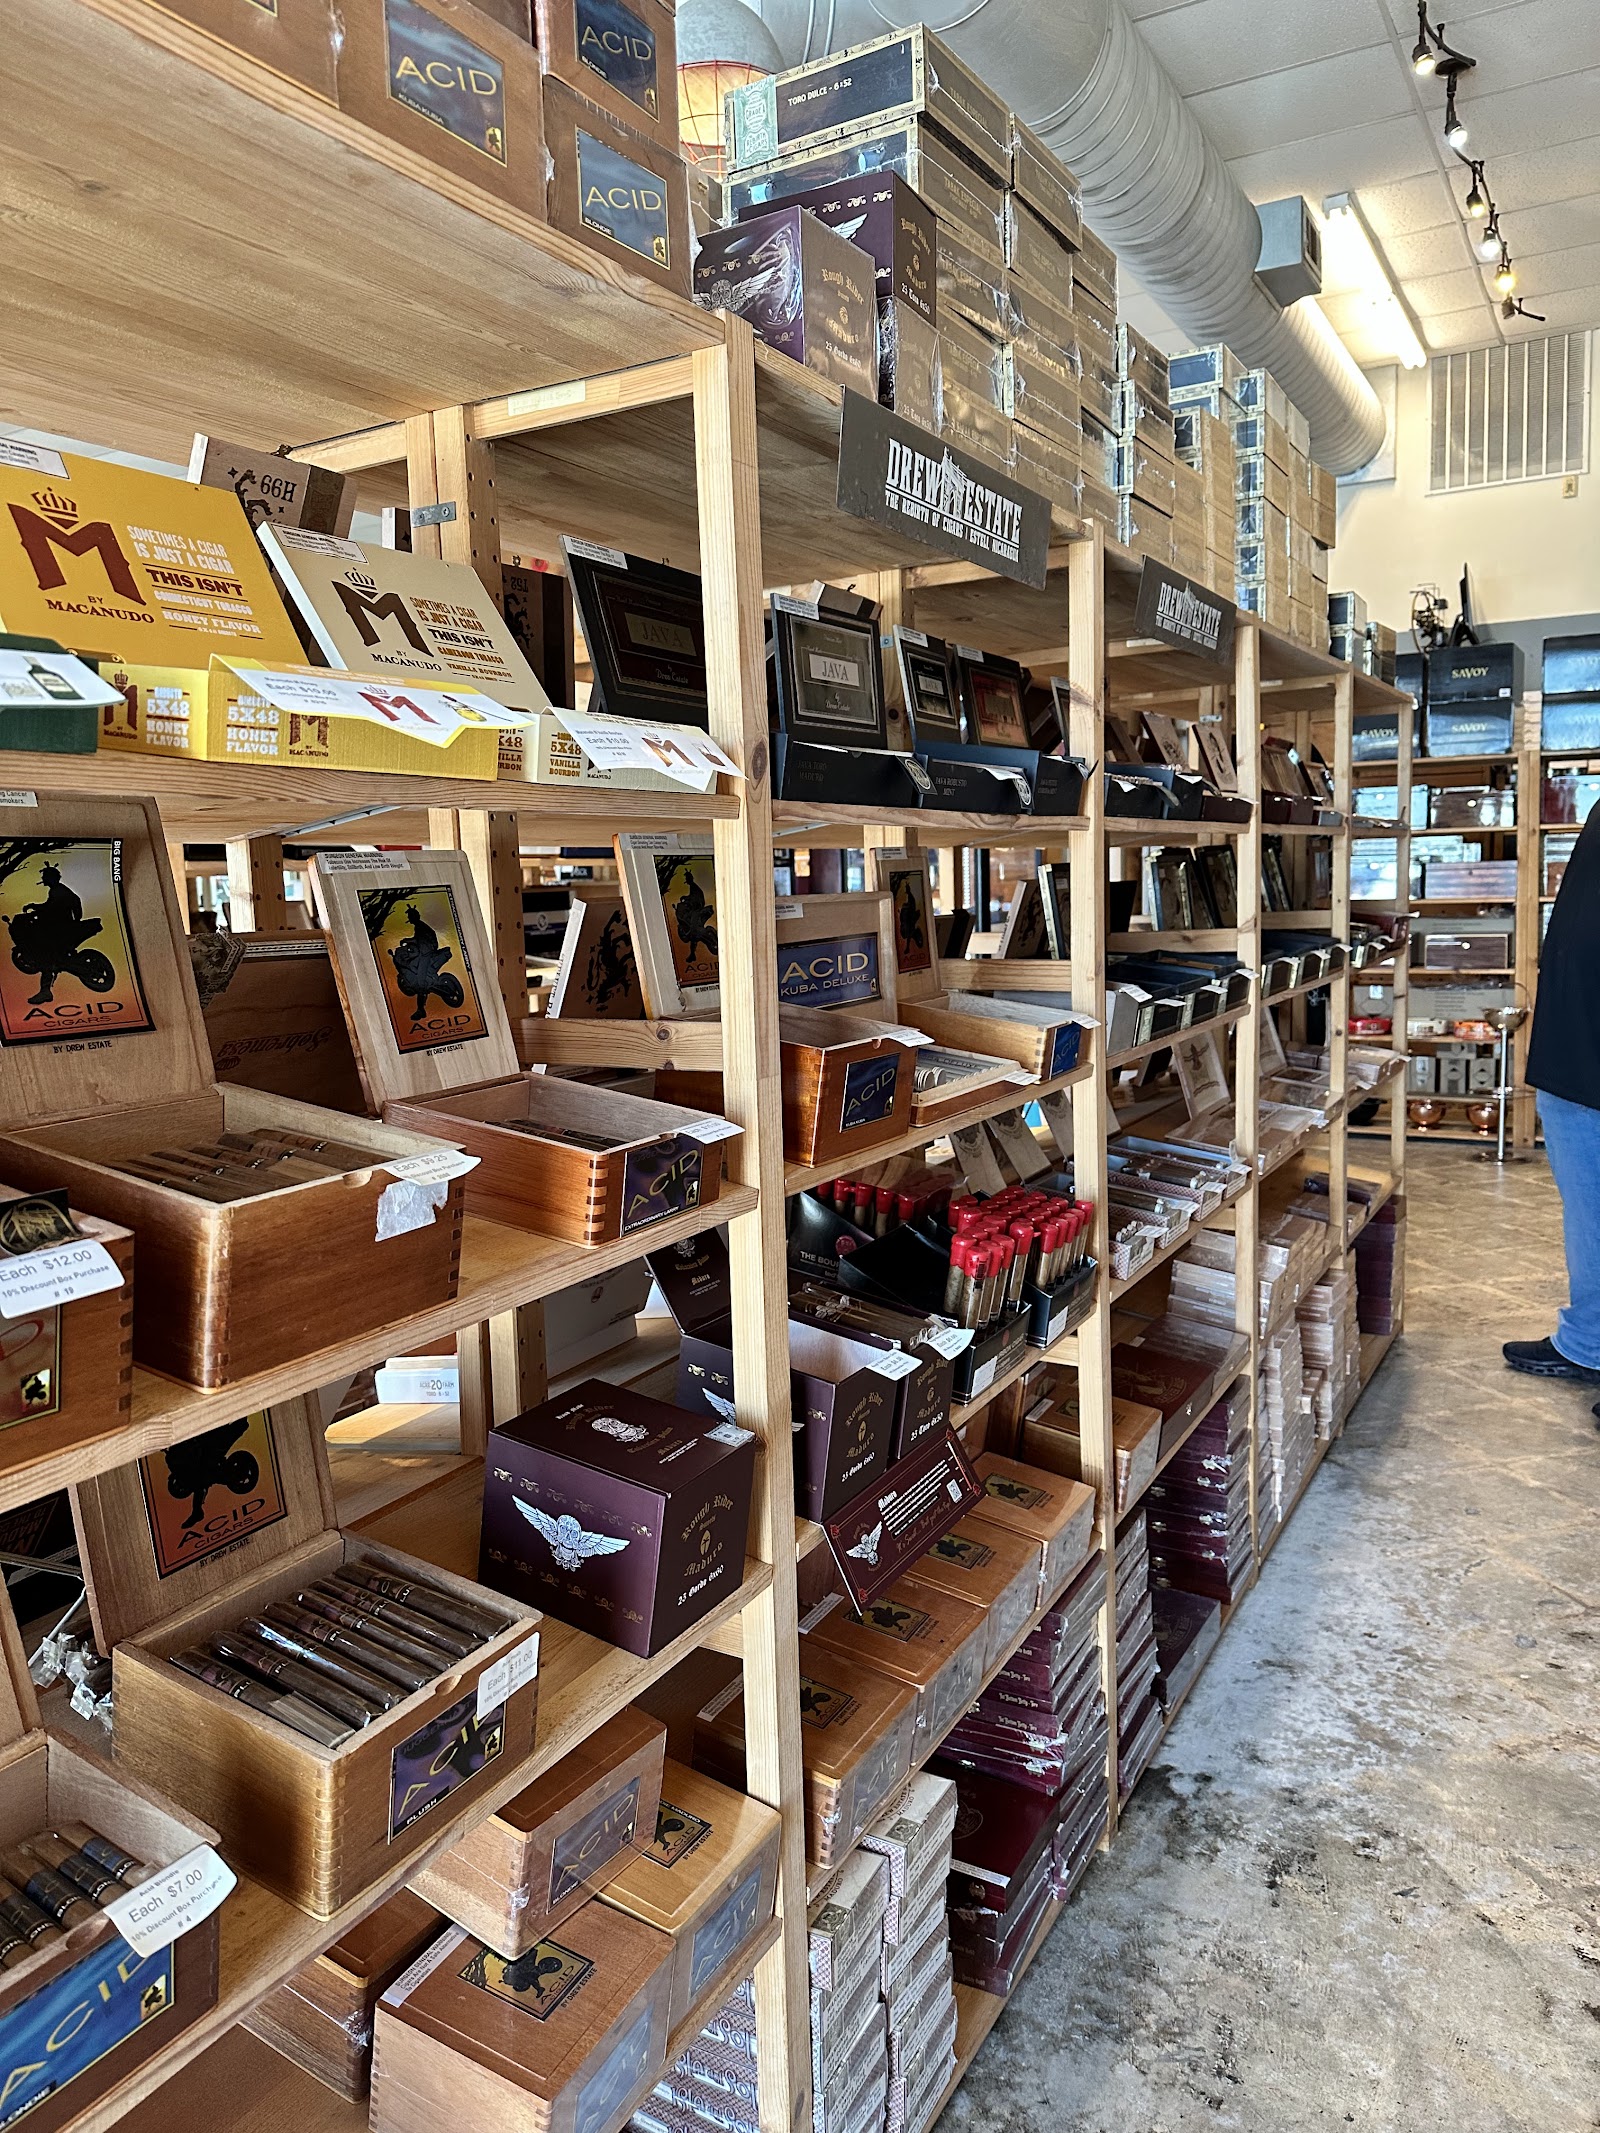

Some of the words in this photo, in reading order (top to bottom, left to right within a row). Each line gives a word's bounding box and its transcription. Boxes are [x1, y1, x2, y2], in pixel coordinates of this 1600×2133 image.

[581, 25, 652, 61] ACID
[395, 56, 497, 95] ACID
[581, 56, 607, 77] BLONDIE
[787, 94, 807, 107] TORO
[807, 87, 828, 100] DULCE
[585, 186, 662, 211] ACID
[584, 217, 612, 235] BLONDIE
[260, 474, 297, 503] 66H
[887, 438, 942, 506] DREW
[963, 479, 1023, 544] ESTATE
[885, 489, 899, 511] THE
[901, 497, 929, 523] REBIRTH
[932, 511, 940, 528] OF
[942, 517, 964, 538] CIGARS
[127, 524, 187, 550] SOMETIMES
[189, 538, 197, 552] A
[197, 540, 227, 558] CIGAR
[7, 503, 147, 606] M
[133, 541, 150, 558] IS
[153, 545, 184, 564] JUST
[186, 552, 197, 567] A
[197, 554, 235, 574] CIGAR
[145, 568, 194, 589] THIS
[195, 576, 243, 596] ISN'T
[45, 598, 155, 624] MACANUDO
[88, 595, 103, 604] BY
[154, 590, 213, 609] CONNECTICUT
[214, 600, 253, 615] TOBACCO
[409, 596, 451, 614] SOMETIMES
[456, 606, 478, 619] CIGAR
[1158, 581, 1184, 620] DREW
[1192, 600, 1222, 637] ESTATE
[162, 610, 208, 626] HONEY
[211, 618, 261, 634] FLAVOR
[331, 580, 434, 657] M
[416, 610, 430, 621] IS
[430, 612, 451, 625] JUST
[451, 616, 460, 628] A
[459, 617, 486, 632] CIGAR
[427, 628, 462, 643] THIS
[463, 635, 495, 649] ISN'T
[641, 622, 683, 647] JAVA
[370, 653, 442, 672] MACANUDO
[437, 647, 475, 659] CAMEROON
[475, 652, 505, 665] TOBACCO
[446, 663, 478, 673] VANILLA
[479, 667, 513, 678] BOURBON
[822, 661, 849, 681] JAVA
[1452, 667, 1489, 679] SAVOY
[146, 699, 190, 717] 5X48
[226, 706, 280, 725] 5X48
[146, 720, 190, 736] HONEY
[226, 727, 279, 743] HONEY
[1361, 728, 1397, 738] SAVOY
[1452, 722, 1488, 733] SAVOY
[146, 734, 190, 749] FLAVOR
[226, 741, 279, 756] FLAVOR
[550, 741, 582, 756] 5X48
[549, 768, 581, 777] BOURBON
[550, 758, 581, 770] VANILLA
[113, 841, 121, 857] BIG
[113, 857, 122, 882] BANG
[780, 953, 869, 984] ACID
[903, 953, 926, 961] ACID
[780, 983, 818, 997] KUBA
[823, 973, 869, 989] DELUXE
[23, 1001, 123, 1022] ACID
[44, 1015, 112, 1028] CIGARS
[409, 1014, 471, 1034] ACID
[422, 1027, 464, 1039] CIGARS
[53, 1045, 63, 1053] BY
[65, 1043, 85, 1052] DREW
[88, 1040, 112, 1050] ESTATE
[433, 1046, 447, 1055] DREW
[446, 1043, 464, 1053] ESTATE
[1054, 1031, 1080, 1065] ACID
[846, 1067, 895, 1117] ACID
[393, 1161, 419, 1173] Each
[627, 1150, 698, 1219] ACID
[624, 1211, 664, 1232] EXTRAORDINARY
[0, 1264, 37, 1281] Each
[43, 1249, 92, 1270] $12.00
[800, 1250, 816, 1262] THE
[2, 1287, 20, 1298] 10%
[21, 1279, 57, 1293] Discount
[57, 1274, 72, 1284] Box
[73, 1265, 110, 1279] Purchase
[430, 1379, 443, 1390] 20
[177, 1498, 265, 1550] ACID
[682, 1502, 710, 1542] Rough
[713, 1494, 733, 1510] Rider
[194, 1516, 254, 1549] CIGARS
[210, 1550, 227, 1562] DREW
[229, 1537, 251, 1551] ESTATE
[684, 1542, 723, 1576] Maduro
[487, 1672, 506, 1690] Each
[406, 1797, 438, 1825] PLUSH
[671, 1805, 702, 1824] MADURO
[897, 1796, 915, 1816] MADURO
[555, 1793, 635, 1893] ACID
[666, 1825, 695, 1857] ACID
[689, 1842, 702, 1855] DREW
[699, 1829, 714, 1845] ESTATE
[139, 1884, 155, 1897] Acid
[155, 1869, 179, 1887] Blondie
[552, 1880, 579, 1905] BLONDIE
[823, 1877, 843, 1901] MADURO
[128, 1895, 164, 1923] Each
[167, 1869, 203, 1898] $7.00
[131, 1930, 147, 1942] 10%
[147, 1909, 178, 1934] Discount
[177, 1901, 191, 1913] Box
[190, 1875, 222, 1903] Purchase
[541, 1965, 574, 2005] ACID
[567, 1985, 582, 2001] DREW
[580, 1967, 598, 1986] ESTATE
[720, 2019, 753, 2060] Sol
[724, 2069, 759, 2112] Sol
